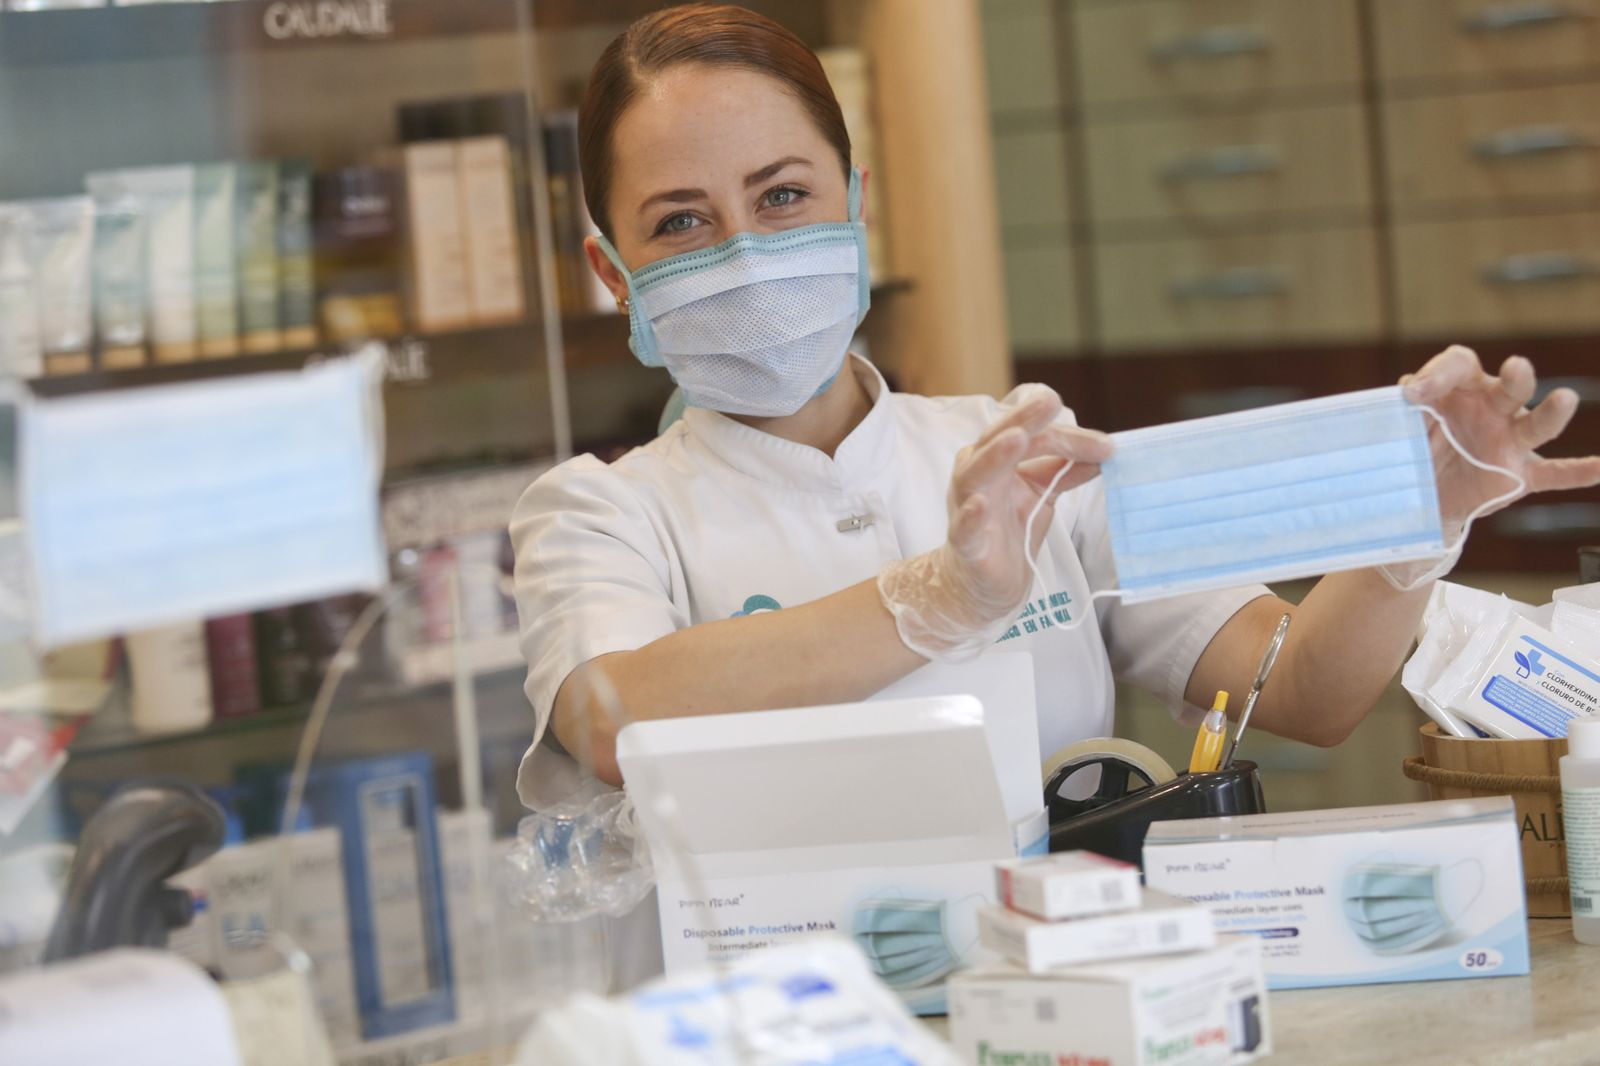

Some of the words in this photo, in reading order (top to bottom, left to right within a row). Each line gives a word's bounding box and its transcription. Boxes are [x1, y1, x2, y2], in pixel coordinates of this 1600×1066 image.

[1541, 681, 1575, 703] CLORURO
[1575, 700, 1586, 710] DE
[1547, 672, 1598, 704] CLORHEXIDINA
[1294, 885, 1326, 896] Mask
[683, 924, 746, 940] Disposable
[749, 922, 804, 935] Protective
[807, 920, 837, 932] Mask
[1466, 952, 1487, 967] 50
